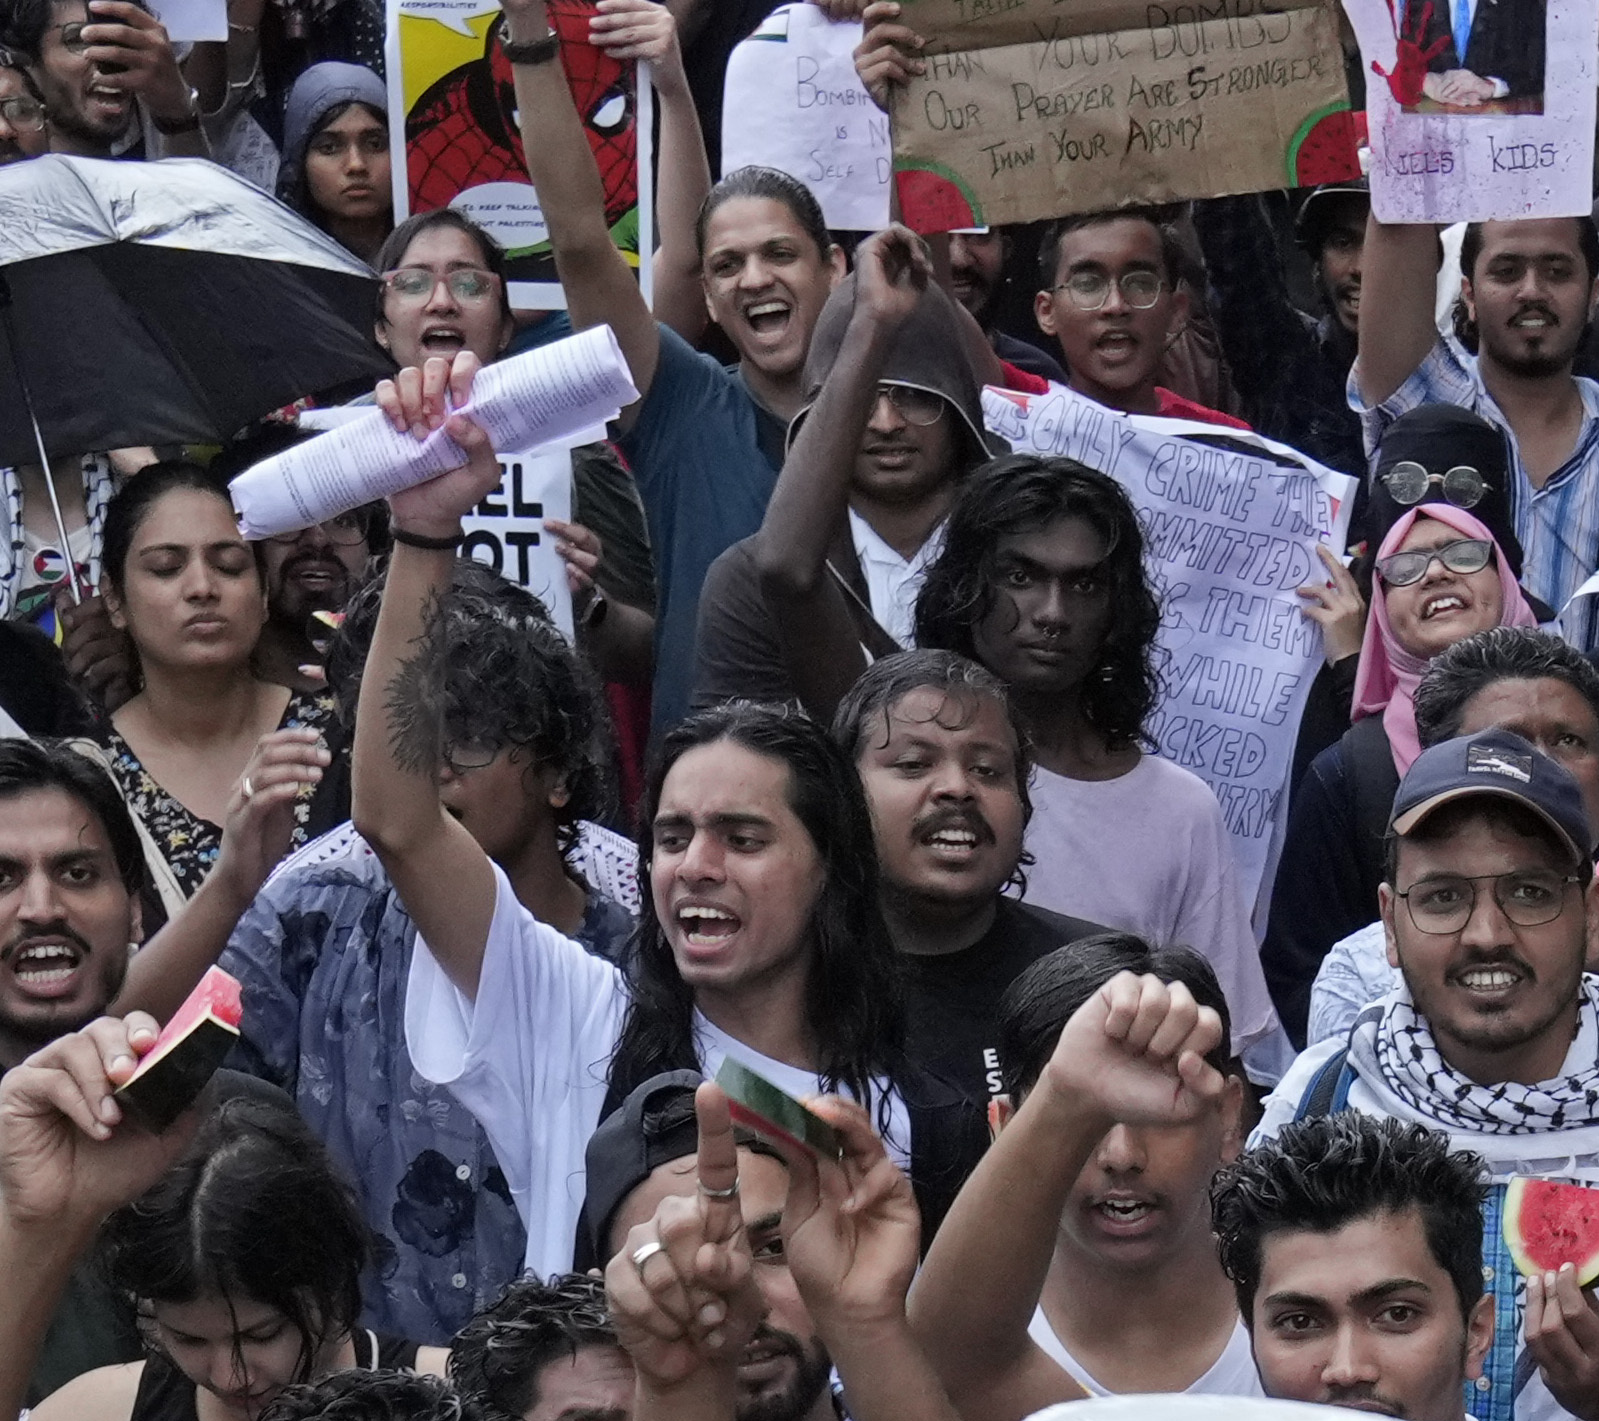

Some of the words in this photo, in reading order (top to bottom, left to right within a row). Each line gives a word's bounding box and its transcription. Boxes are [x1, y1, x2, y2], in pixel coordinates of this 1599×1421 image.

[1033, 20, 1130, 72] YOUR
[923, 90, 982, 132] OUR
[1011, 82, 1115, 123] PRAYER
[1126, 74, 1179, 108] ARE
[1186, 56, 1325, 100] STRONGER
[807, 149, 856, 182] SELF
[981, 141, 1035, 180] THAN
[1049, 129, 1107, 164] YOUR
[1119, 113, 1203, 166] ARMY
[1487, 135, 1559, 173] KIDS
[1031, 395, 1137, 478] ONLY
[1145, 443, 1263, 524] CRIME
[1136, 507, 1312, 592] OMMITTED
[1199, 587, 1317, 660] THEM
[1163, 652, 1301, 727] WHILE
